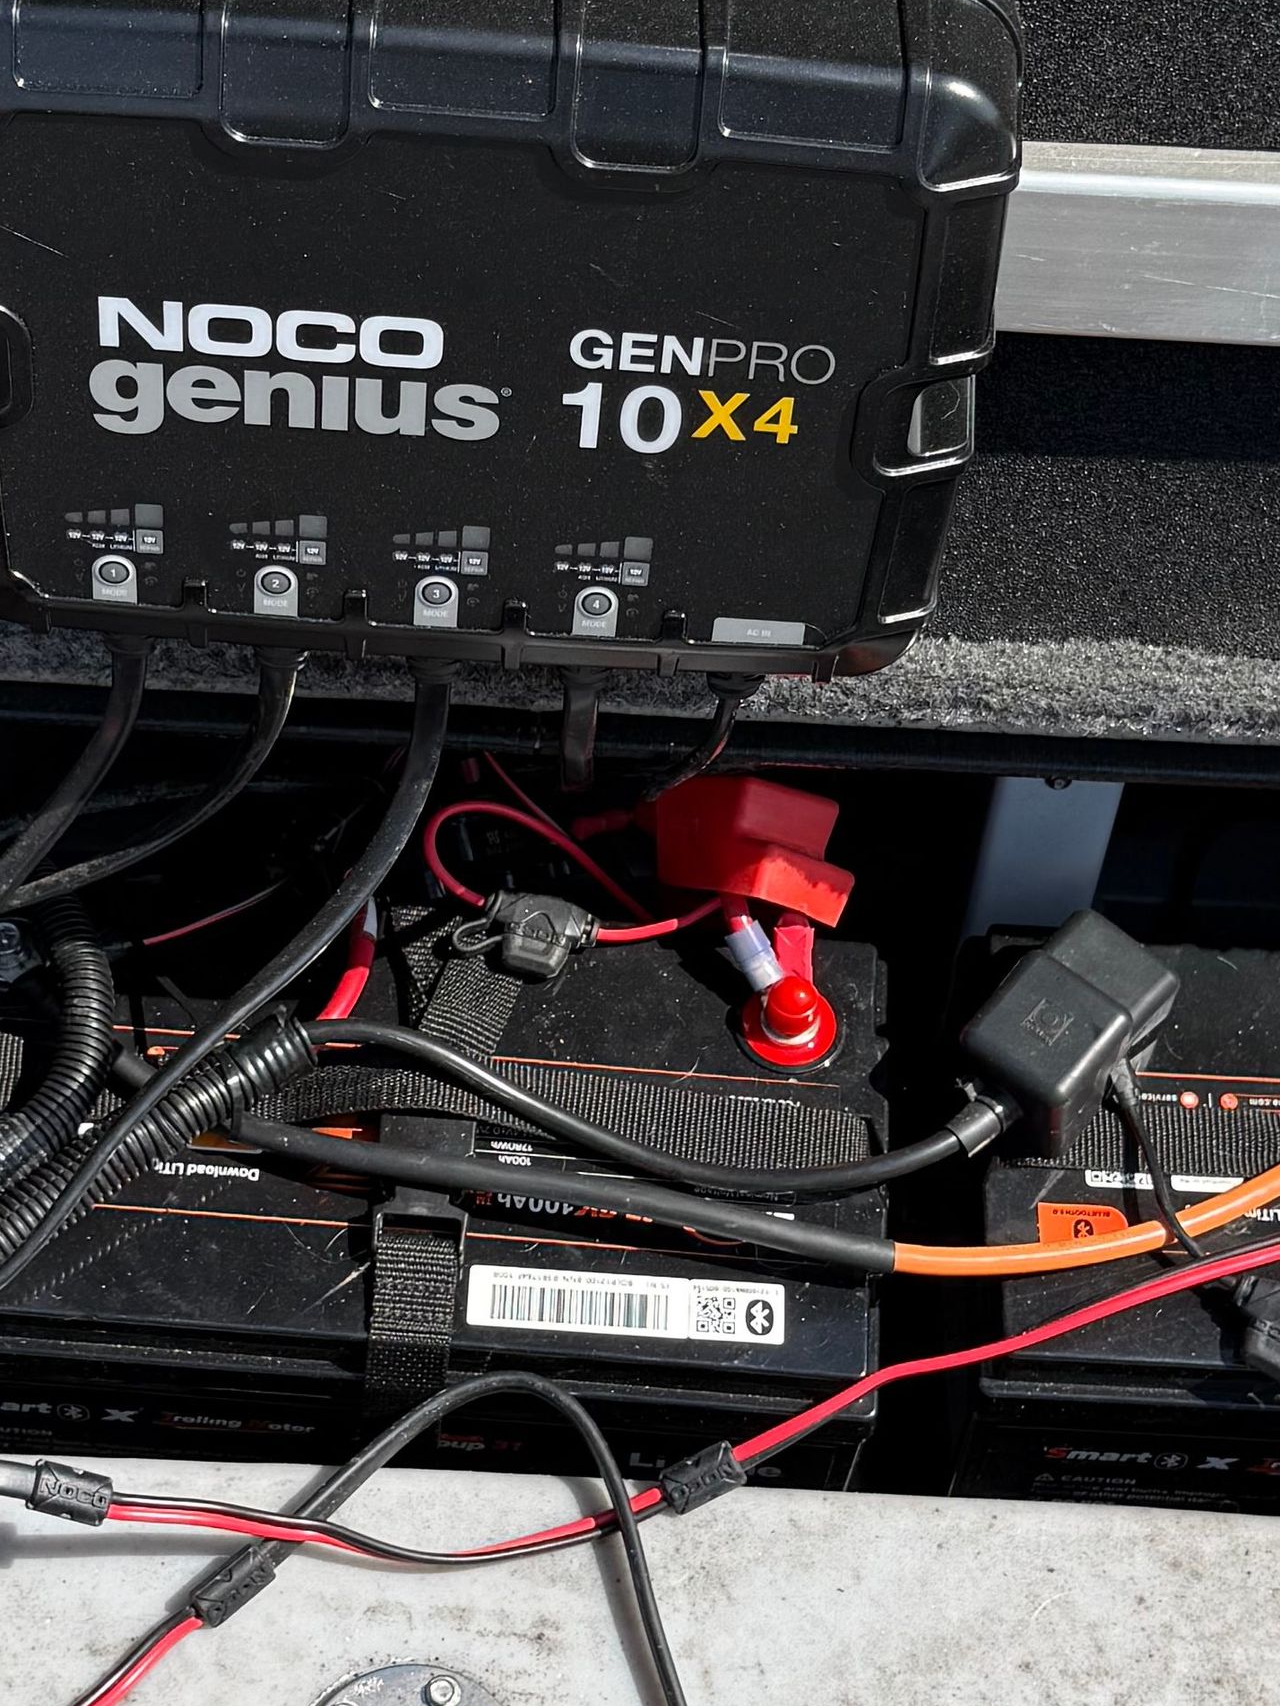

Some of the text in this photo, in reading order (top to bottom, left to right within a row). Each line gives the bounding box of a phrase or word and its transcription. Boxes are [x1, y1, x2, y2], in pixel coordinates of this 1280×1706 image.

[98, 295, 444, 370] NOCO
[569, 329, 836, 388] GENPRO
[88, 357, 501, 442] genius
[110, 568, 116, 578] 1
[272, 579, 280, 589] 2
[432, 589, 440, 599] 3
[592, 599, 600, 609] 4
[746, 628, 772, 638] AC IN
[185, 1163, 261, 1182] Download
[1065, 1209, 1111, 1218] BLUETOOTH
[160, 1410, 318, 1436] Trolling Motor
[629, 1450, 667, 1469] Li
[1042, 1446, 1153, 1465] Smart
[1060, 1474, 1138, 1487] CAUTION
[40, 1475, 108, 1510] NOCO
